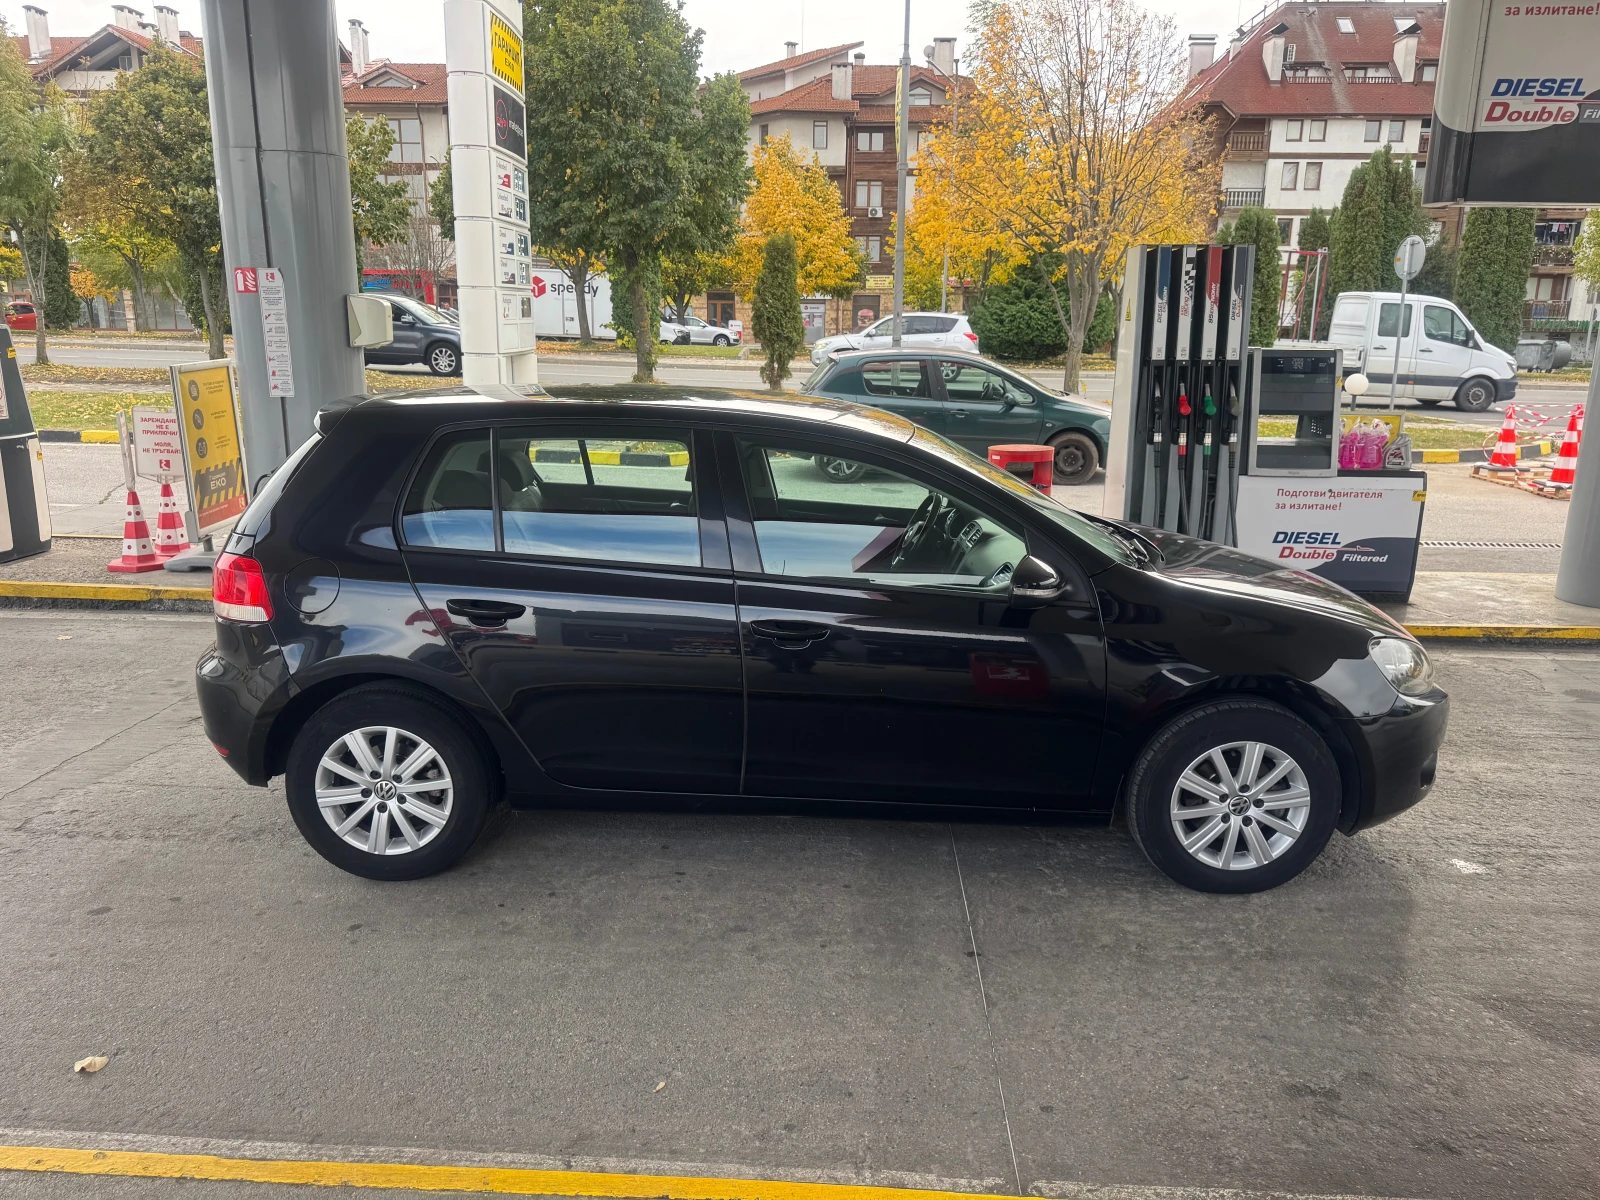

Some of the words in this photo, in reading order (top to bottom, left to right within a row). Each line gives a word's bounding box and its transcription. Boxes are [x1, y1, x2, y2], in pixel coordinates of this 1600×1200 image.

[1505, 6, 1520, 16] за
[1525, 2, 1600, 16] излитане!
[1491, 78, 1586, 96] DIESEL
[1484, 101, 1575, 122] Double
[1583, 108, 1600, 119] Fil
[550, 282, 599, 297] spedy
[1277, 488, 1326, 499] Подготви
[1328, 490, 1383, 500] двигателя
[1275, 502, 1286, 510] за
[1289, 502, 1342, 511] излитане!
[1272, 531, 1341, 545] DIESEL
[1278, 546, 1335, 560] Double
[1342, 553, 1389, 563] Filtered
